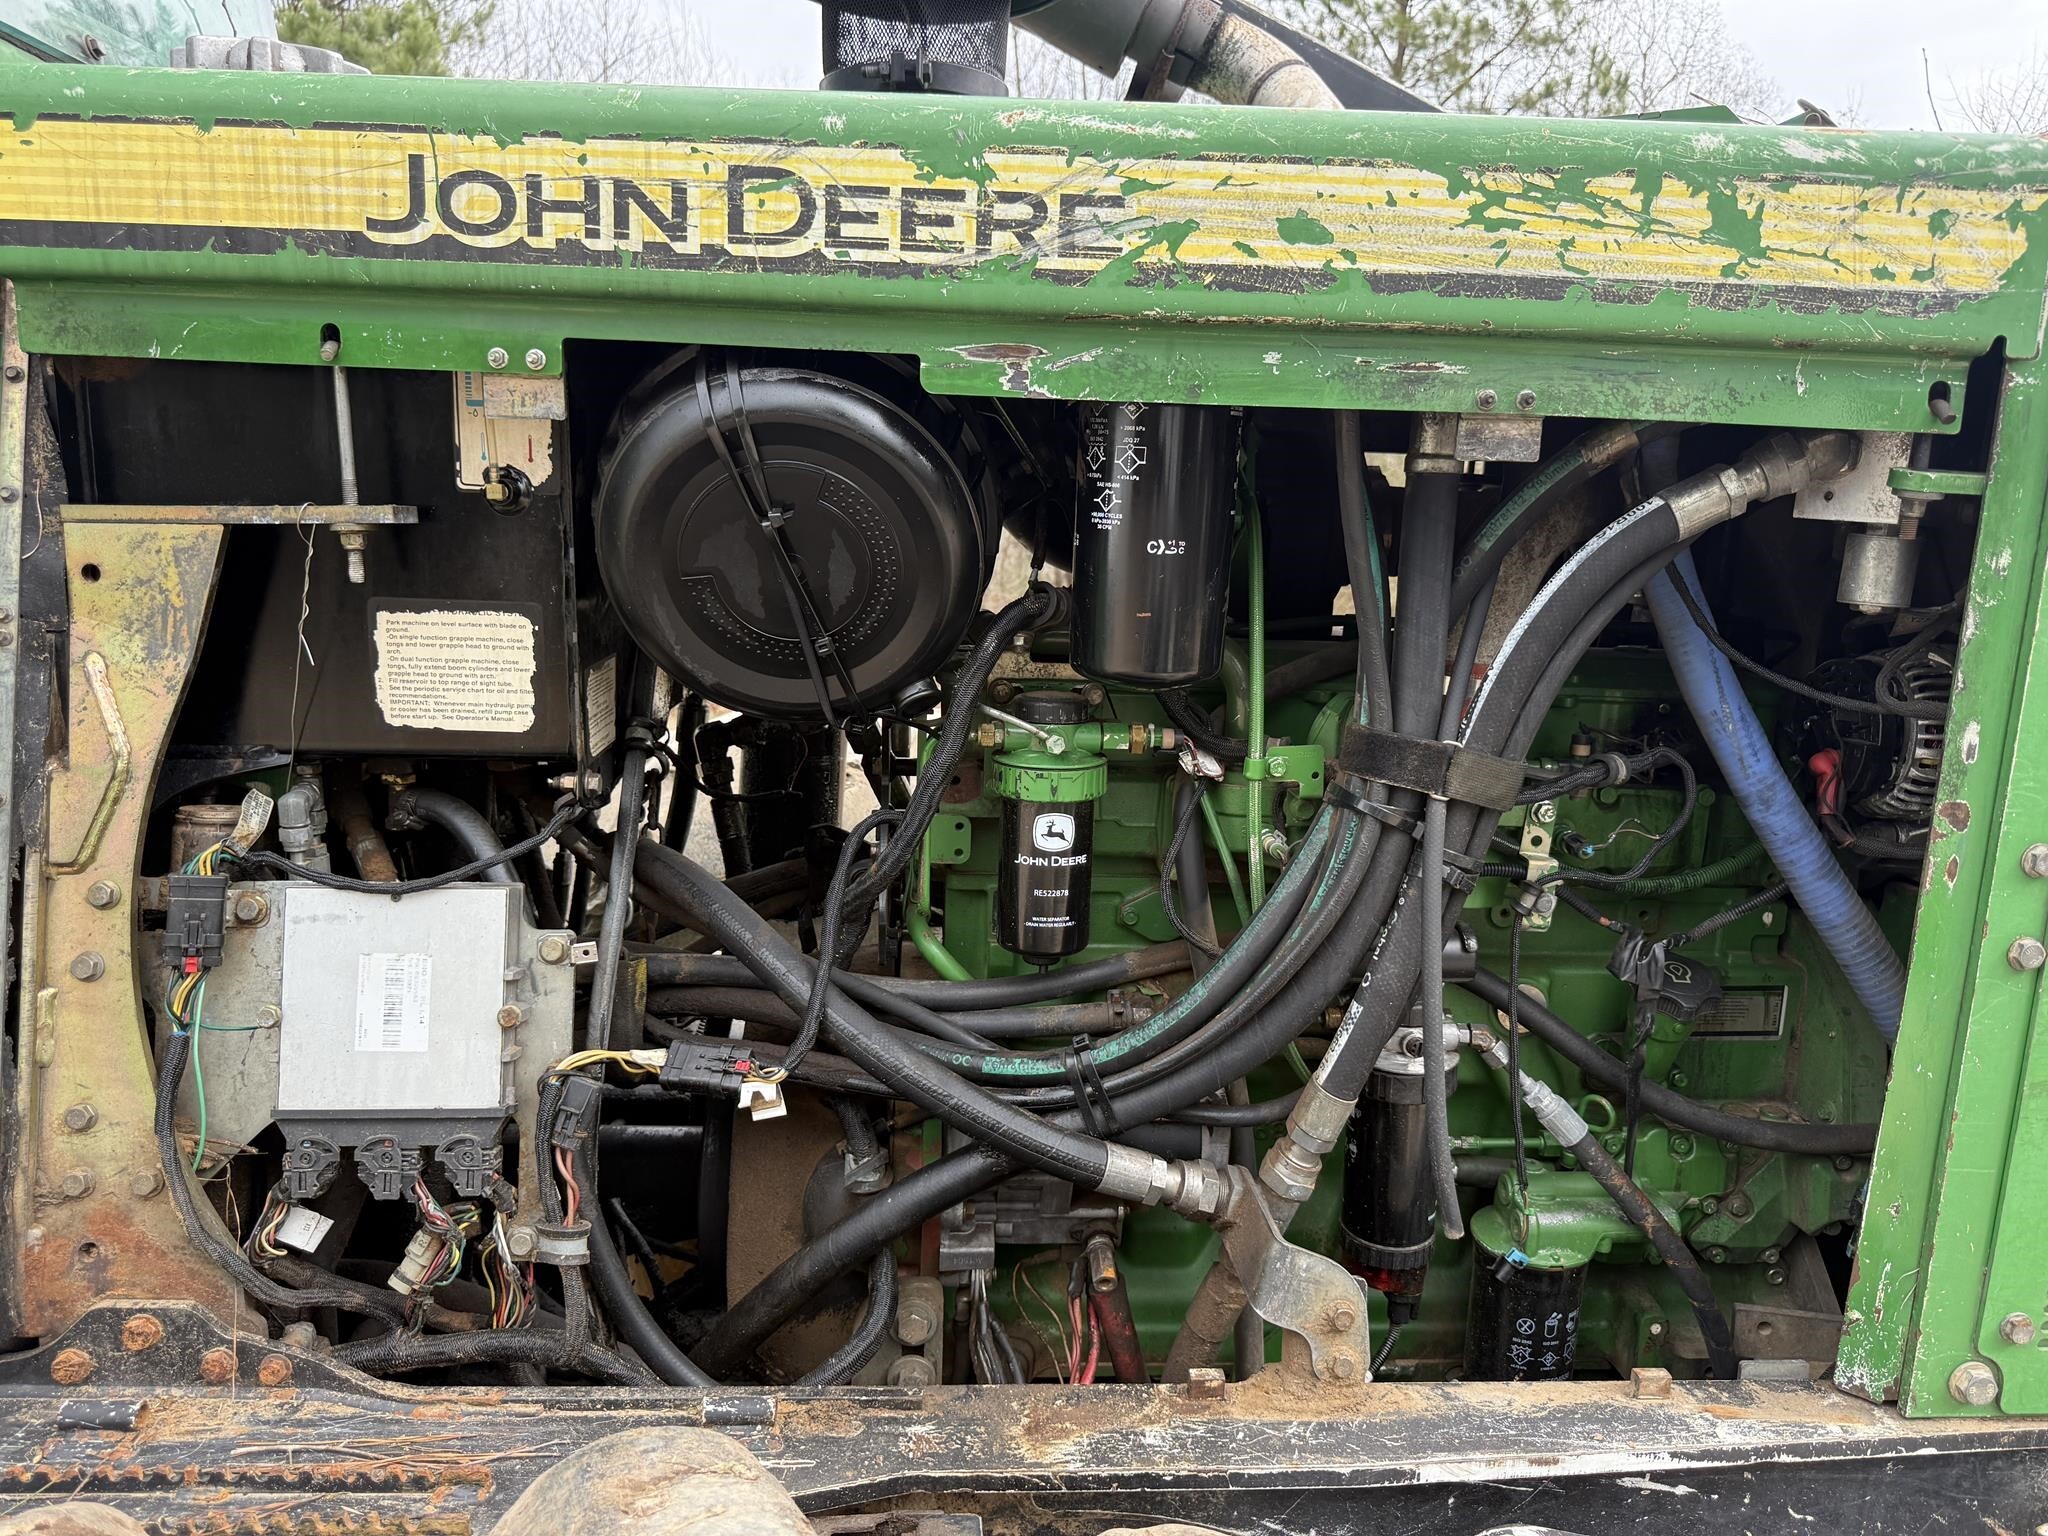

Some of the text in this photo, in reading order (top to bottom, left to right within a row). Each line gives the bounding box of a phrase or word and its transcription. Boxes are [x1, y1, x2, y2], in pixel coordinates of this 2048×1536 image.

[364, 152, 1130, 262] JOHN DEERE
[1014, 853, 1088, 867] JOHN DEERE
[1033, 889, 1069, 897] RE522878
